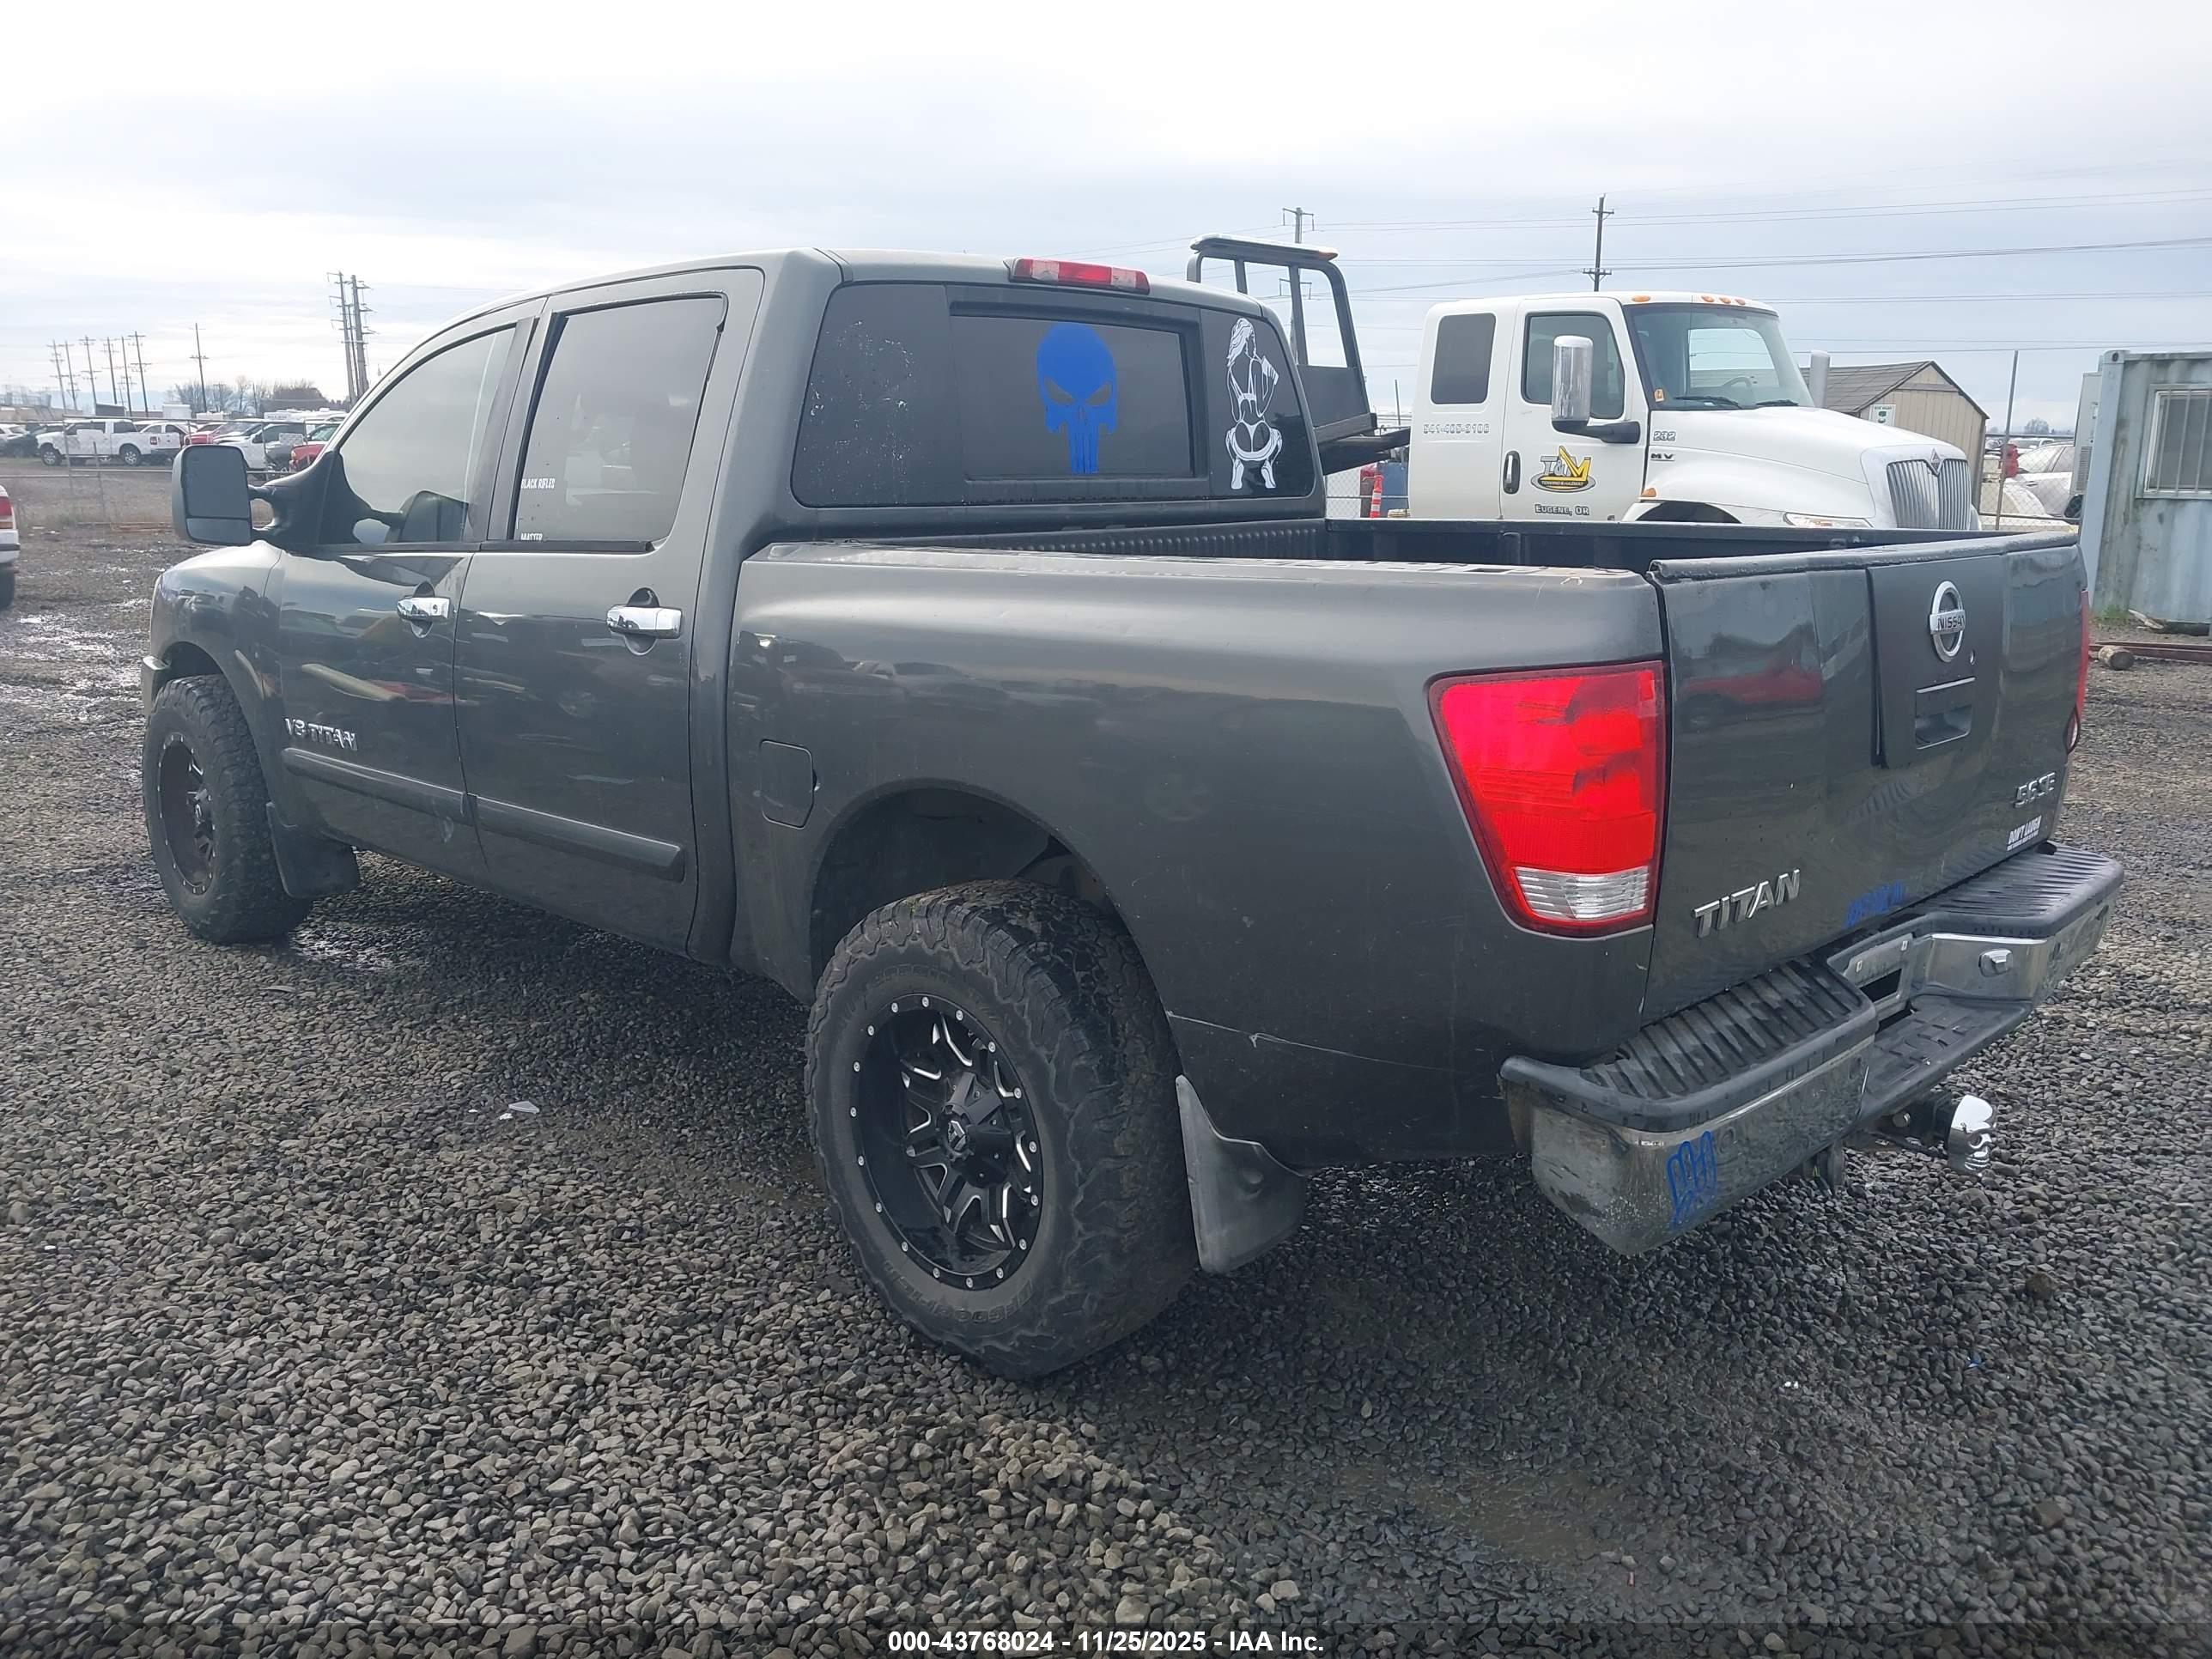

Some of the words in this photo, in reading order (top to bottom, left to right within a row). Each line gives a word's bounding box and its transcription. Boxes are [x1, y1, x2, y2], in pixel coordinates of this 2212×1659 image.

[1653, 430, 1676, 441] 232
[521, 478, 538, 489] BLACK
[538, 477, 556, 489] RIFLES
[1574, 506, 1590, 516] OR
[1937, 614, 1965, 629] NISSAN
[284, 718, 306, 736] V8
[307, 722, 358, 751] TITAN
[1692, 869, 1801, 939] TITAN
